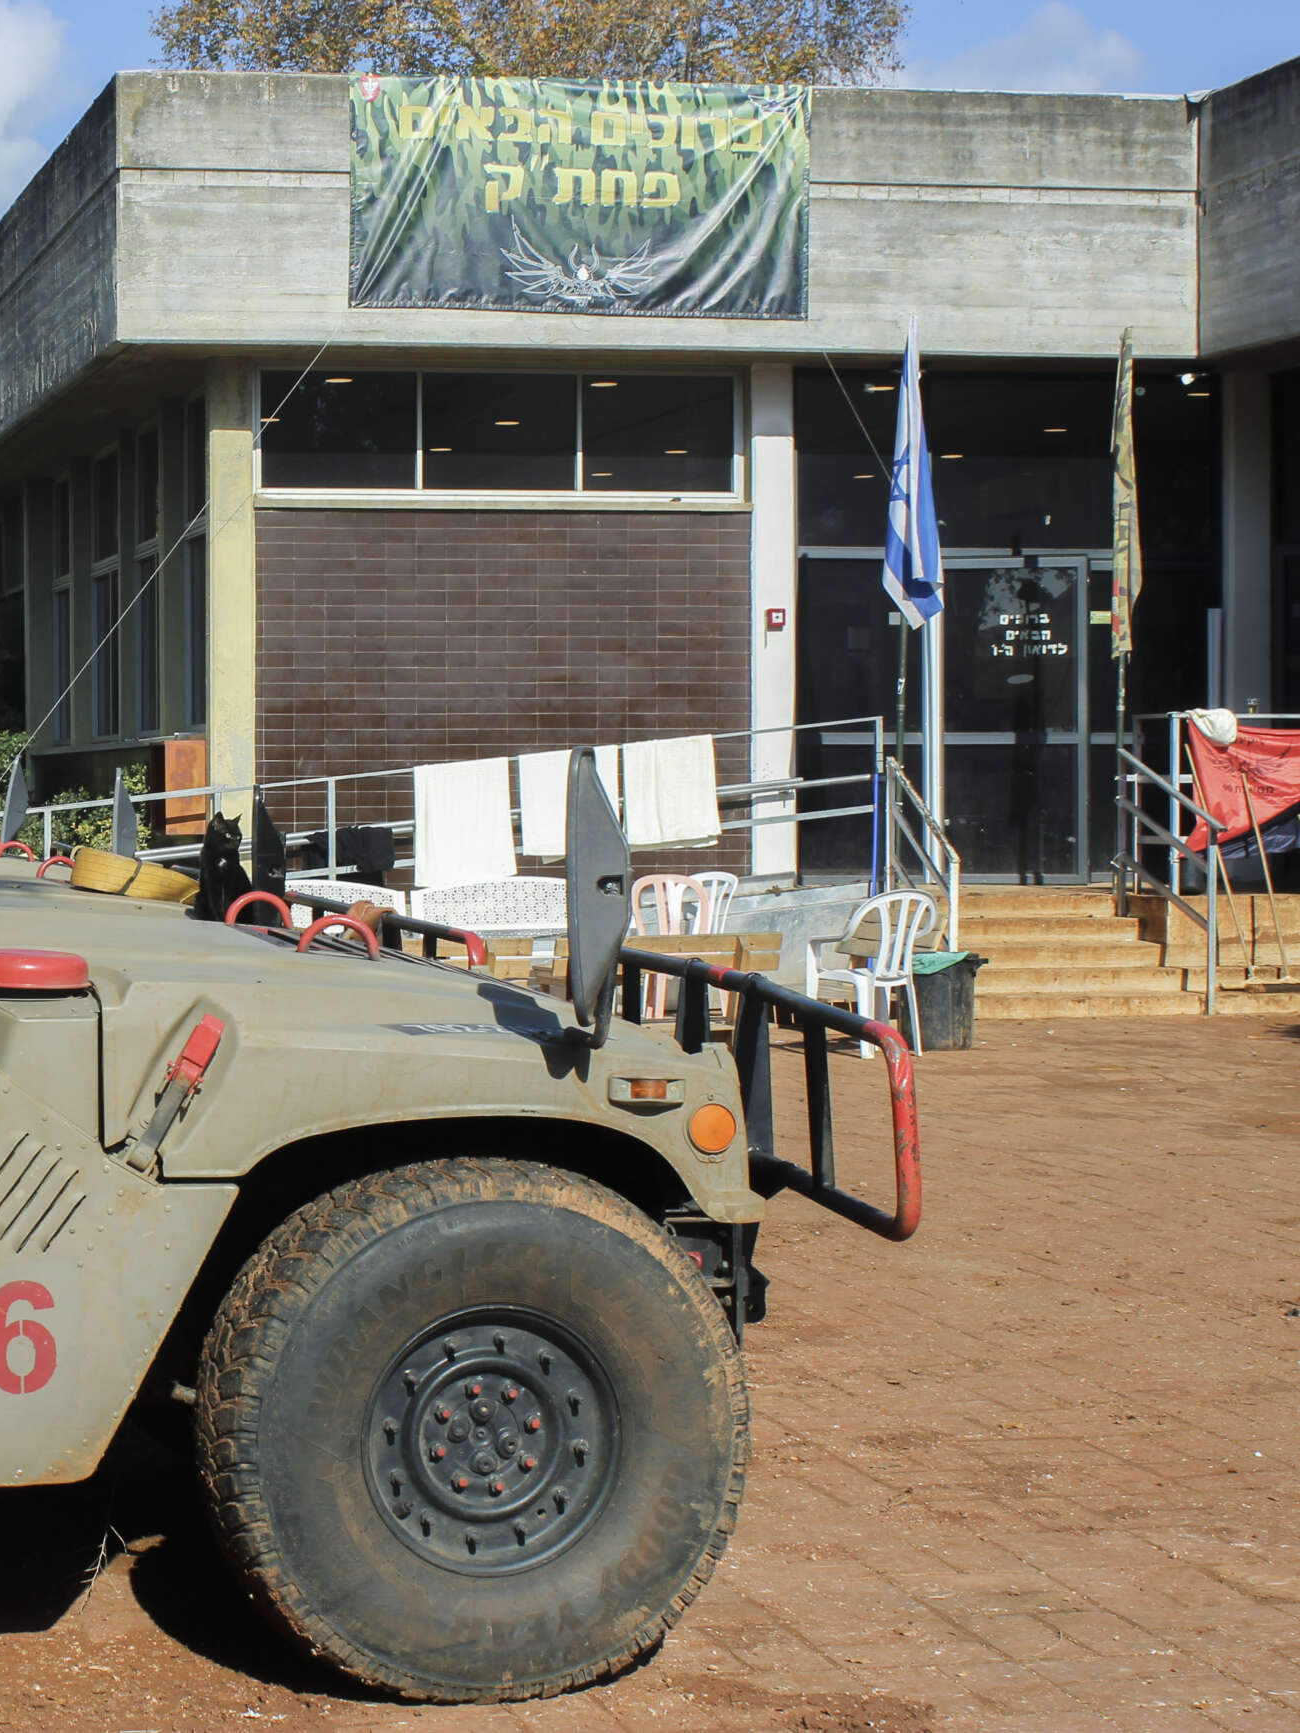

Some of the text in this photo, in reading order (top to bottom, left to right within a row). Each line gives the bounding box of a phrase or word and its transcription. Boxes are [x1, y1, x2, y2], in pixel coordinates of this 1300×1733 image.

[400, 104, 765, 153] ברוכים הבאים
[999, 613, 1050, 625] ברוכים
[1005, 629, 1051, 640] הבאים
